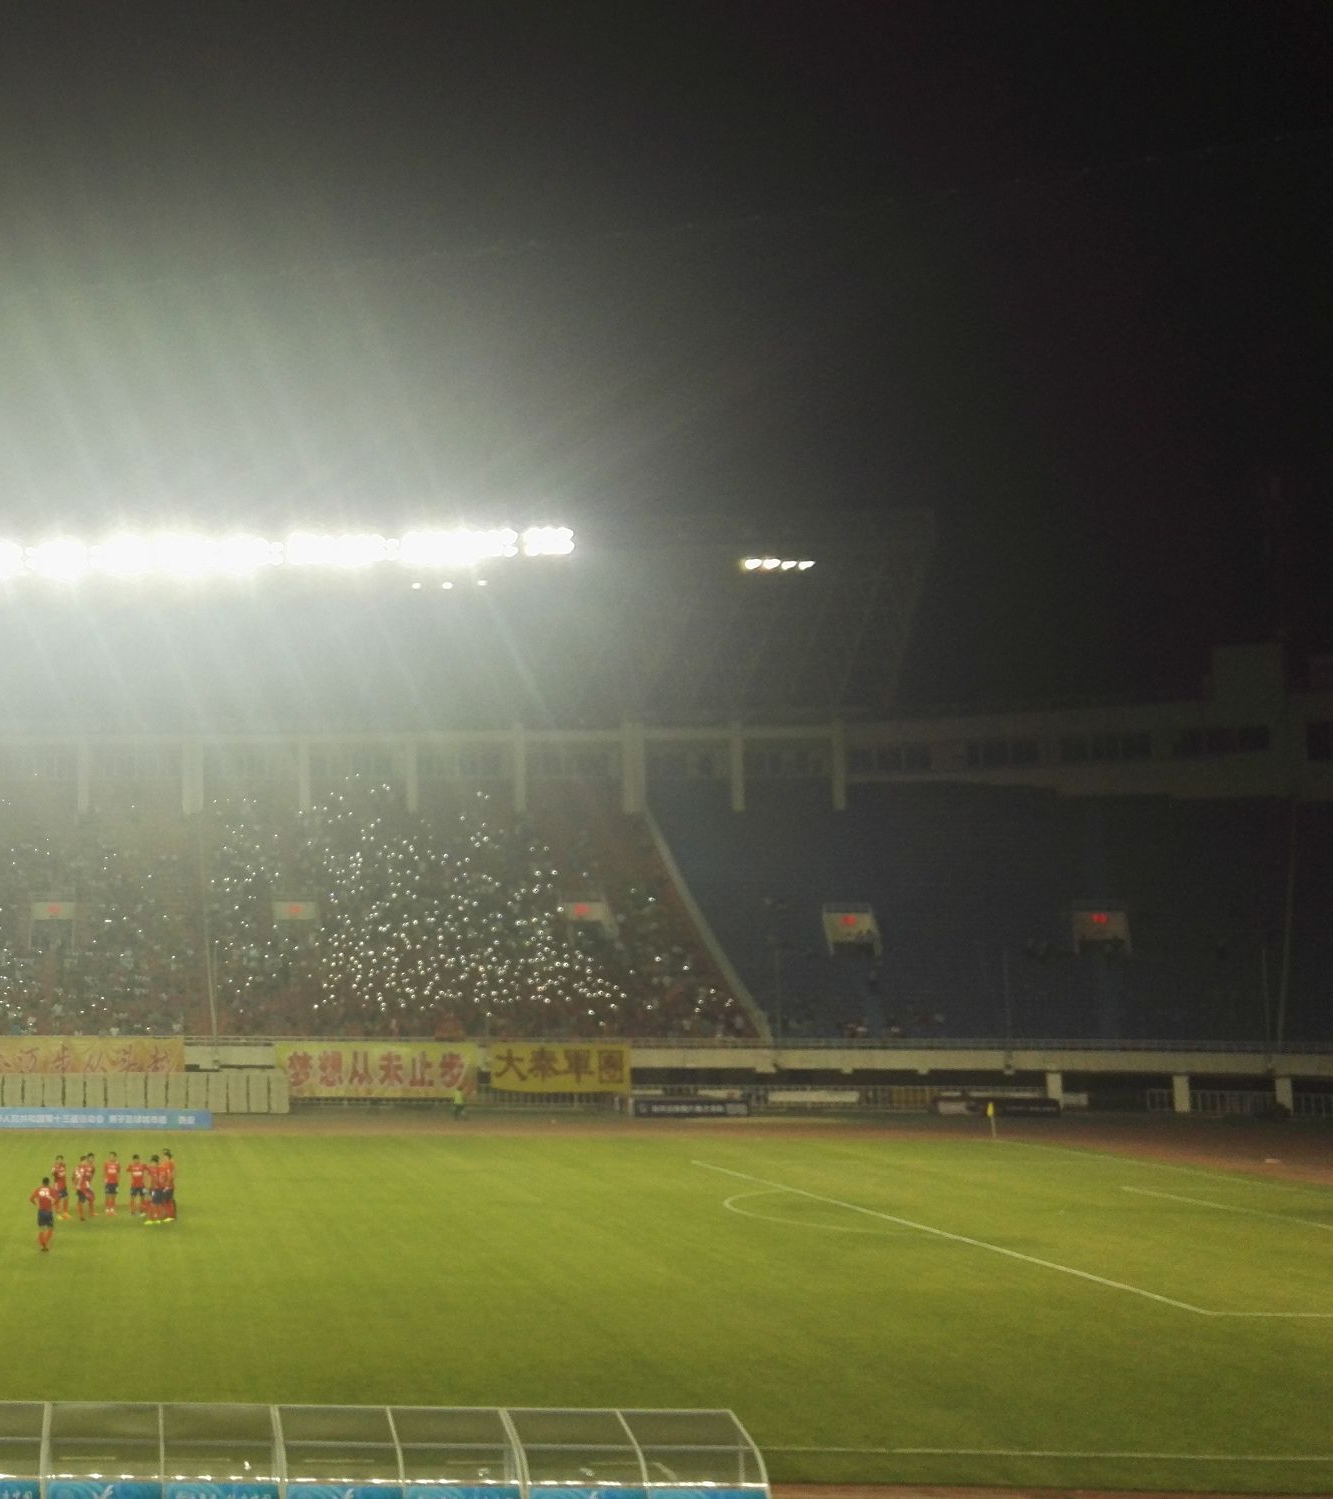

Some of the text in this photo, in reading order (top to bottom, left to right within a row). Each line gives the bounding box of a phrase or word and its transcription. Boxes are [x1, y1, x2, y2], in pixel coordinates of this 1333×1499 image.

[288, 1050, 464, 1087] 梦想从未止步
